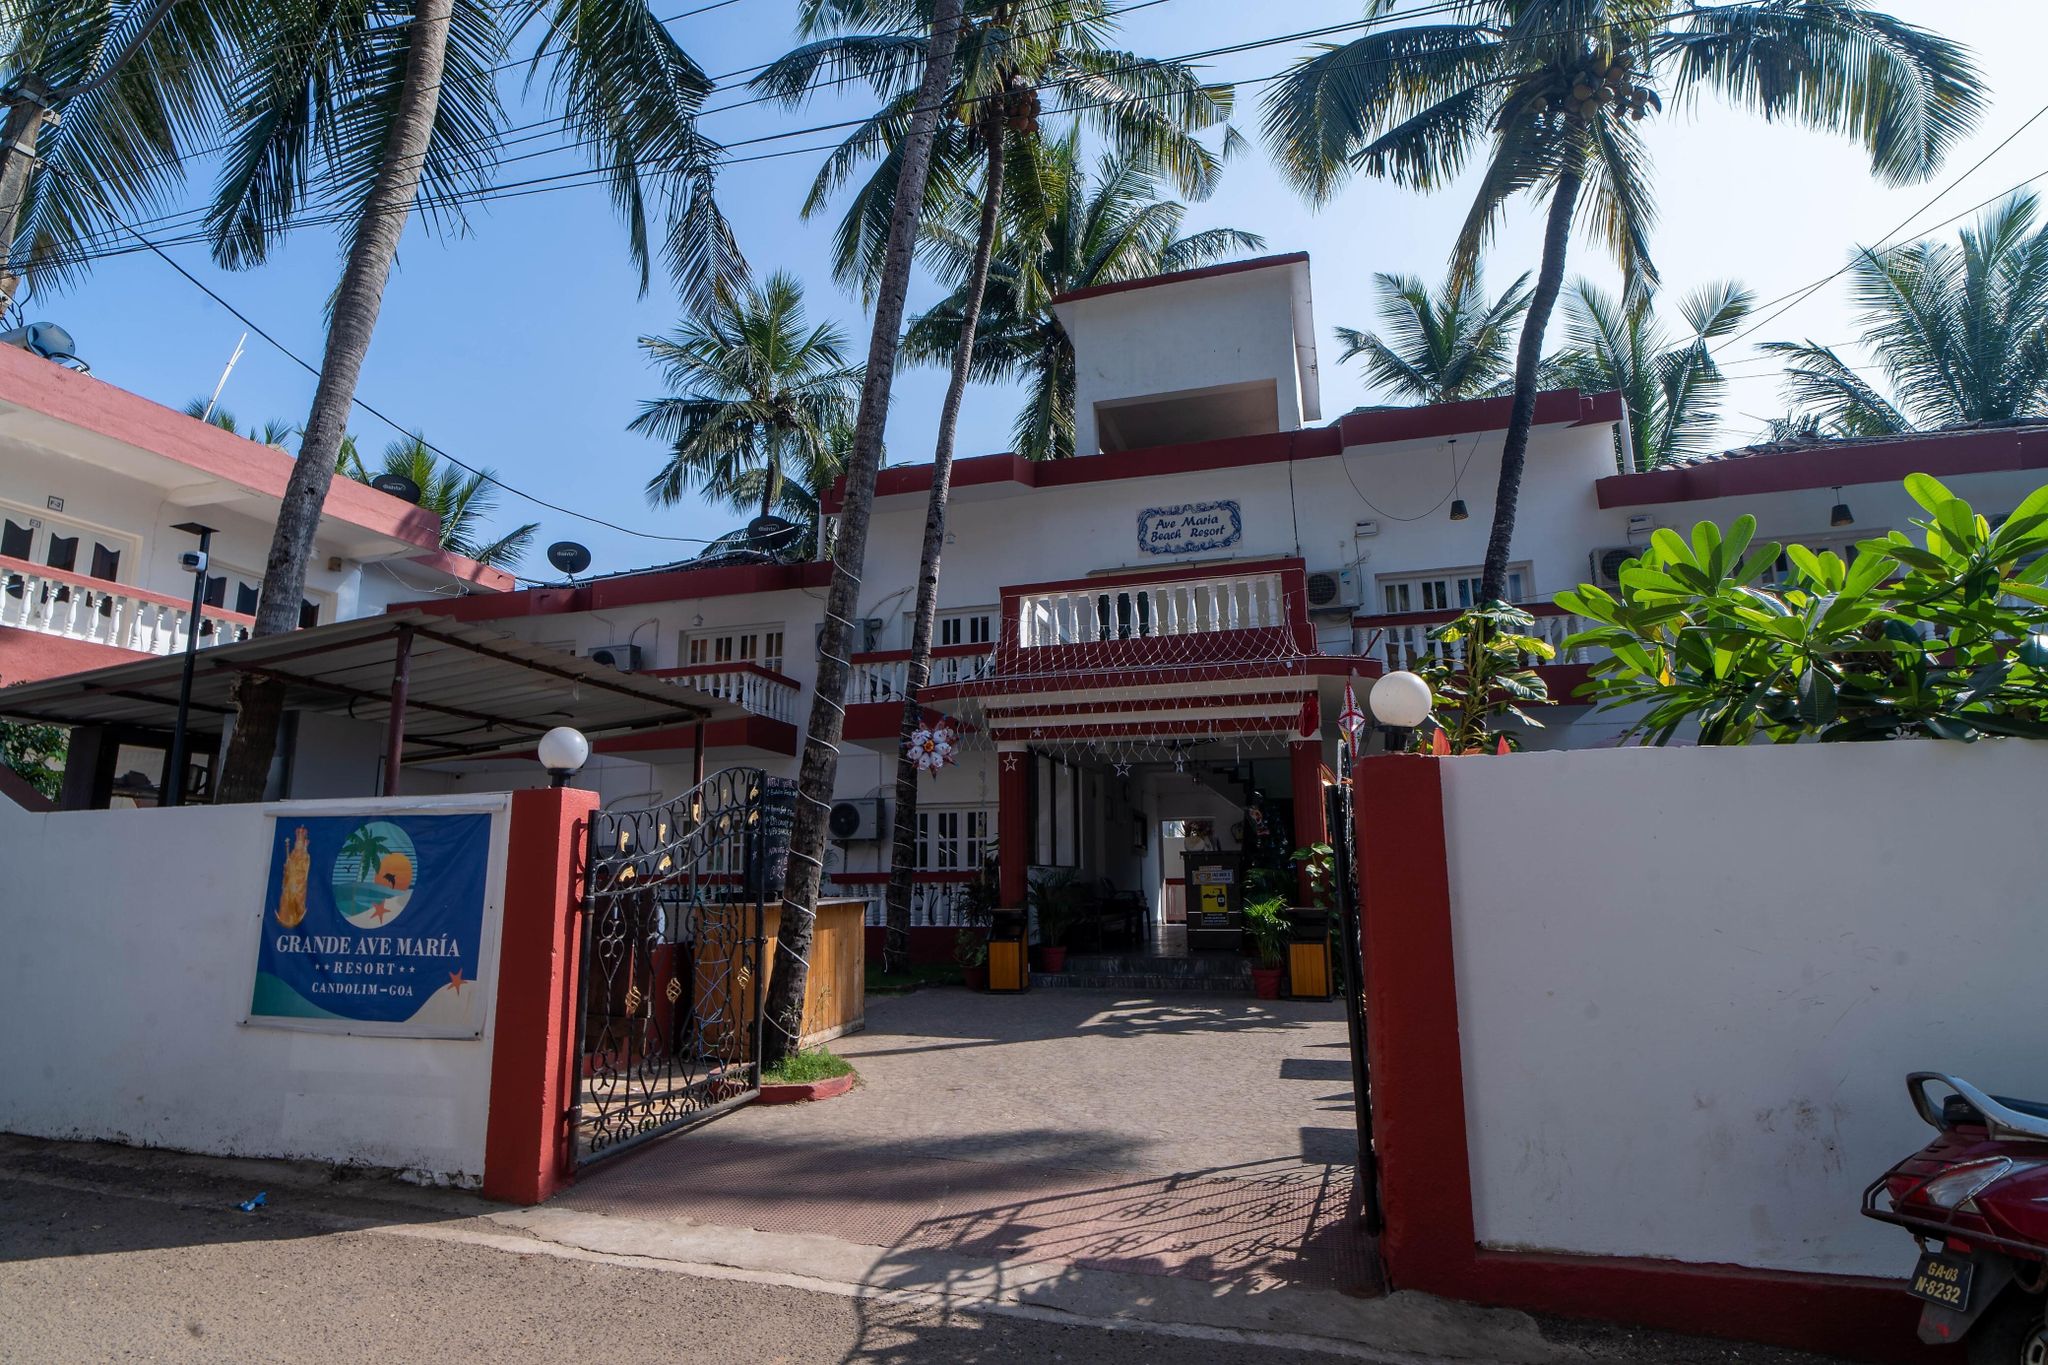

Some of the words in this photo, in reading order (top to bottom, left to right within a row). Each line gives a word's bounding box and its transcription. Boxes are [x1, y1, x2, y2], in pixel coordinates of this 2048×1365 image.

[1155, 519, 1176, 530] Ave
[1181, 514, 1218, 527] Maria
[1151, 529, 1181, 543] Beach
[1190, 525, 1226, 538] Resort
[276, 935, 351, 953] GRANDE
[354, 937, 392, 955] AVE
[396, 933, 460, 957] MARÍA
[333, 961, 397, 975] RESORT
